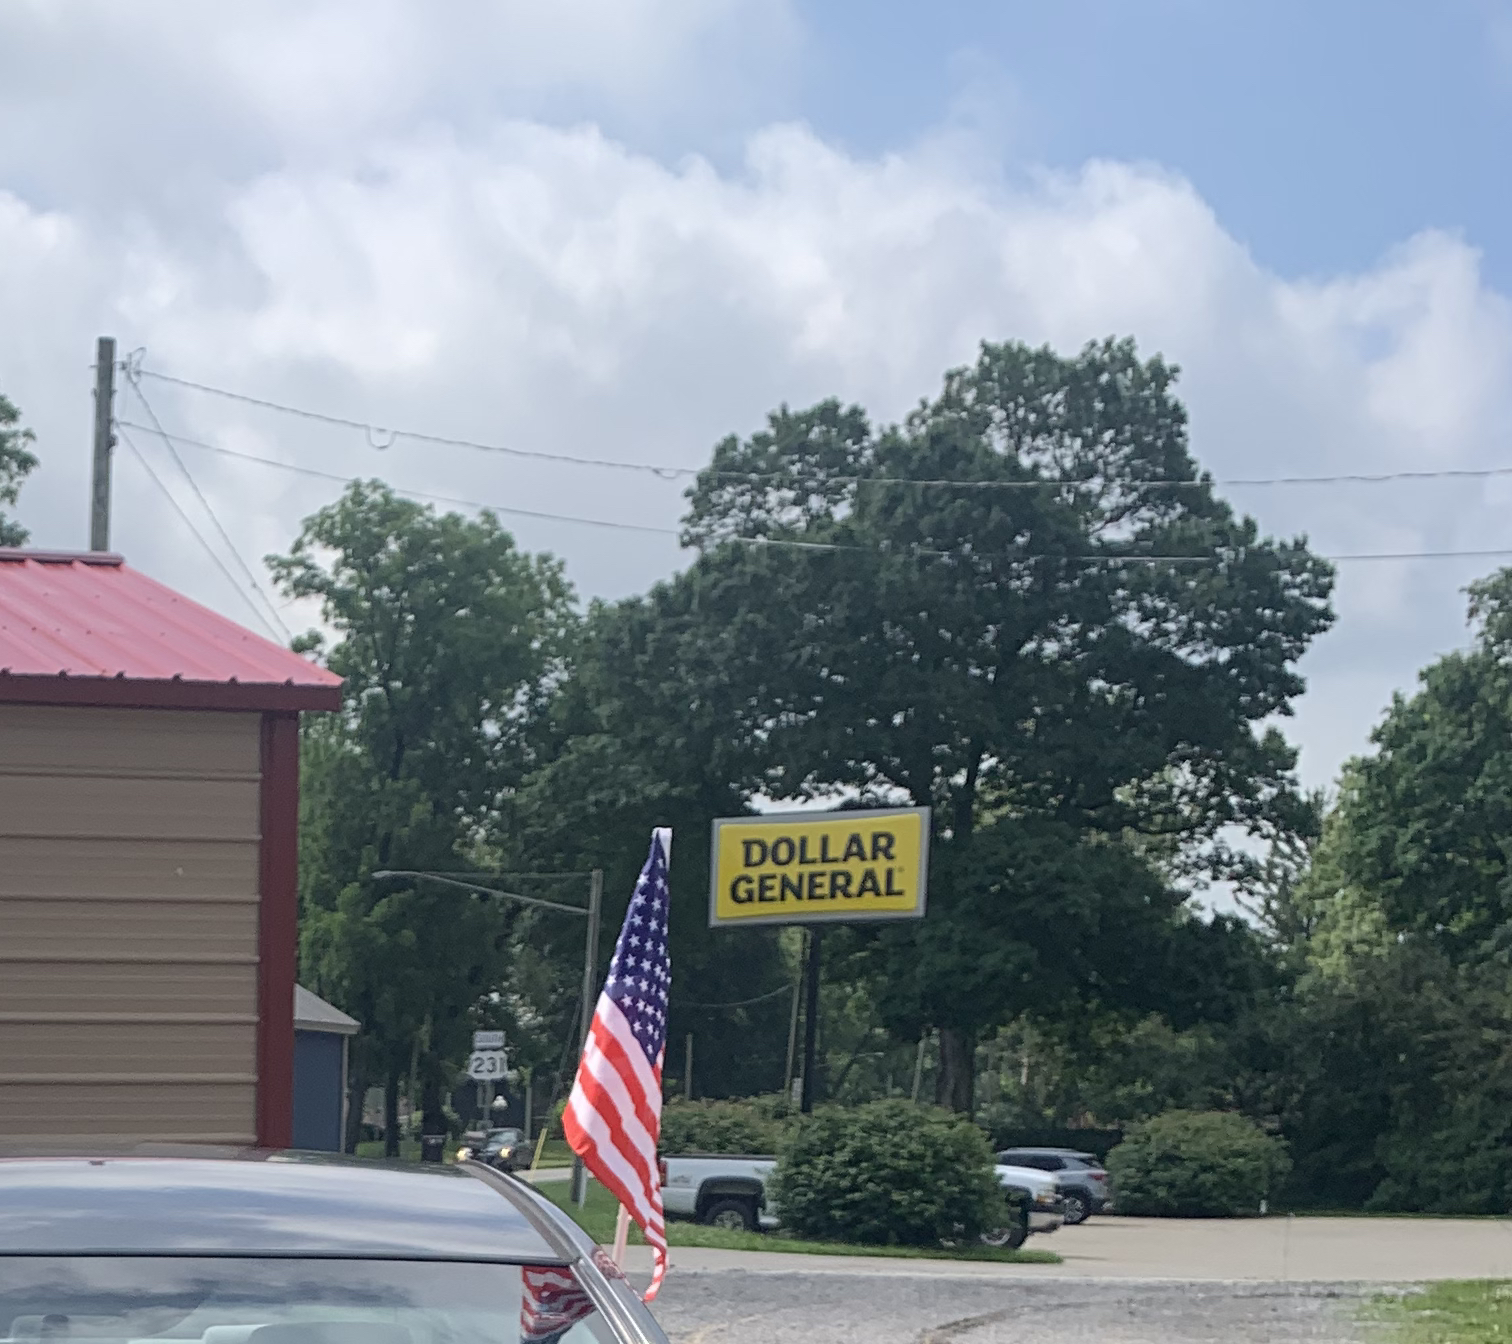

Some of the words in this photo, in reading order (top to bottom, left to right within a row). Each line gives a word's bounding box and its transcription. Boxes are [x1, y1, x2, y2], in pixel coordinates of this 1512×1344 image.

[742, 831, 896, 868] DOLLAR
[730, 867, 904, 904] GENERAL
[473, 1057, 505, 1073] 231
